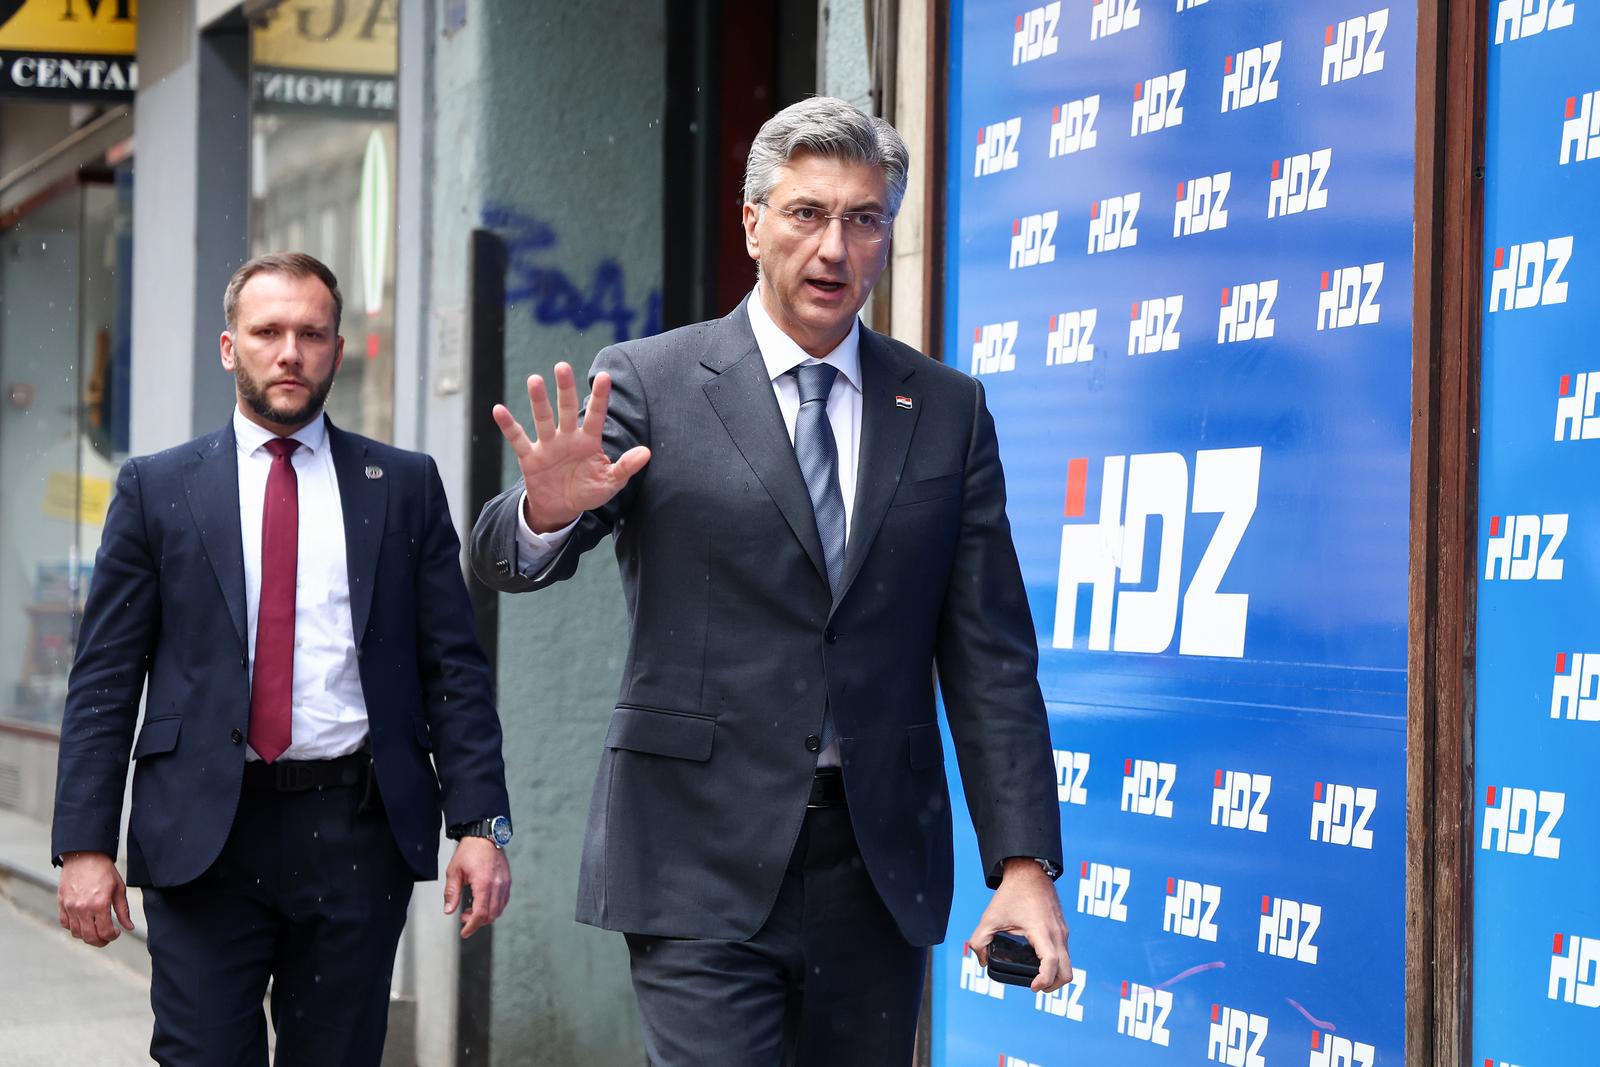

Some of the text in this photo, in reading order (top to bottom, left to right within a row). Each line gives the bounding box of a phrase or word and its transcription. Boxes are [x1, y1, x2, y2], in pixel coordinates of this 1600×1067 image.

[1012, 0, 1061, 66] HDZ
[1321, 8, 1389, 86] HDZ
[1131, 69, 1187, 137] HDZ
[1221, 41, 1282, 113] HDZ
[974, 117, 1021, 177] HDZ
[1049, 94, 1100, 158] HDZ
[1173, 172, 1231, 238] HDZ
[1267, 148, 1332, 219] HDZ
[1009, 211, 1058, 269] HDZ
[1087, 192, 1141, 254] HDZ
[1317, 262, 1384, 331] HDZ
[1489, 236, 1574, 313] HDZ
[1045, 308, 1097, 366] HDZ
[1128, 295, 1183, 356] HDZ
[1217, 280, 1278, 344] HDZ
[971, 321, 1018, 375] HDZ
[1052, 446, 1262, 658] HDZ
[1485, 514, 1569, 580] HDZ
[1053, 749, 1090, 805] DZ
[1121, 759, 1177, 818] HDZ
[1211, 770, 1272, 833] HDZ
[1310, 782, 1377, 850] HDZ
[1481, 786, 1565, 859] HDZ
[1077, 861, 1130, 922] HDZ
[1163, 878, 1221, 942] HDZ
[1258, 896, 1322, 965] HDZ
[1548, 933, 1600, 1008] HD
[1117, 981, 1173, 1047] HDZ
[1207, 1003, 1269, 1067] HDZ
